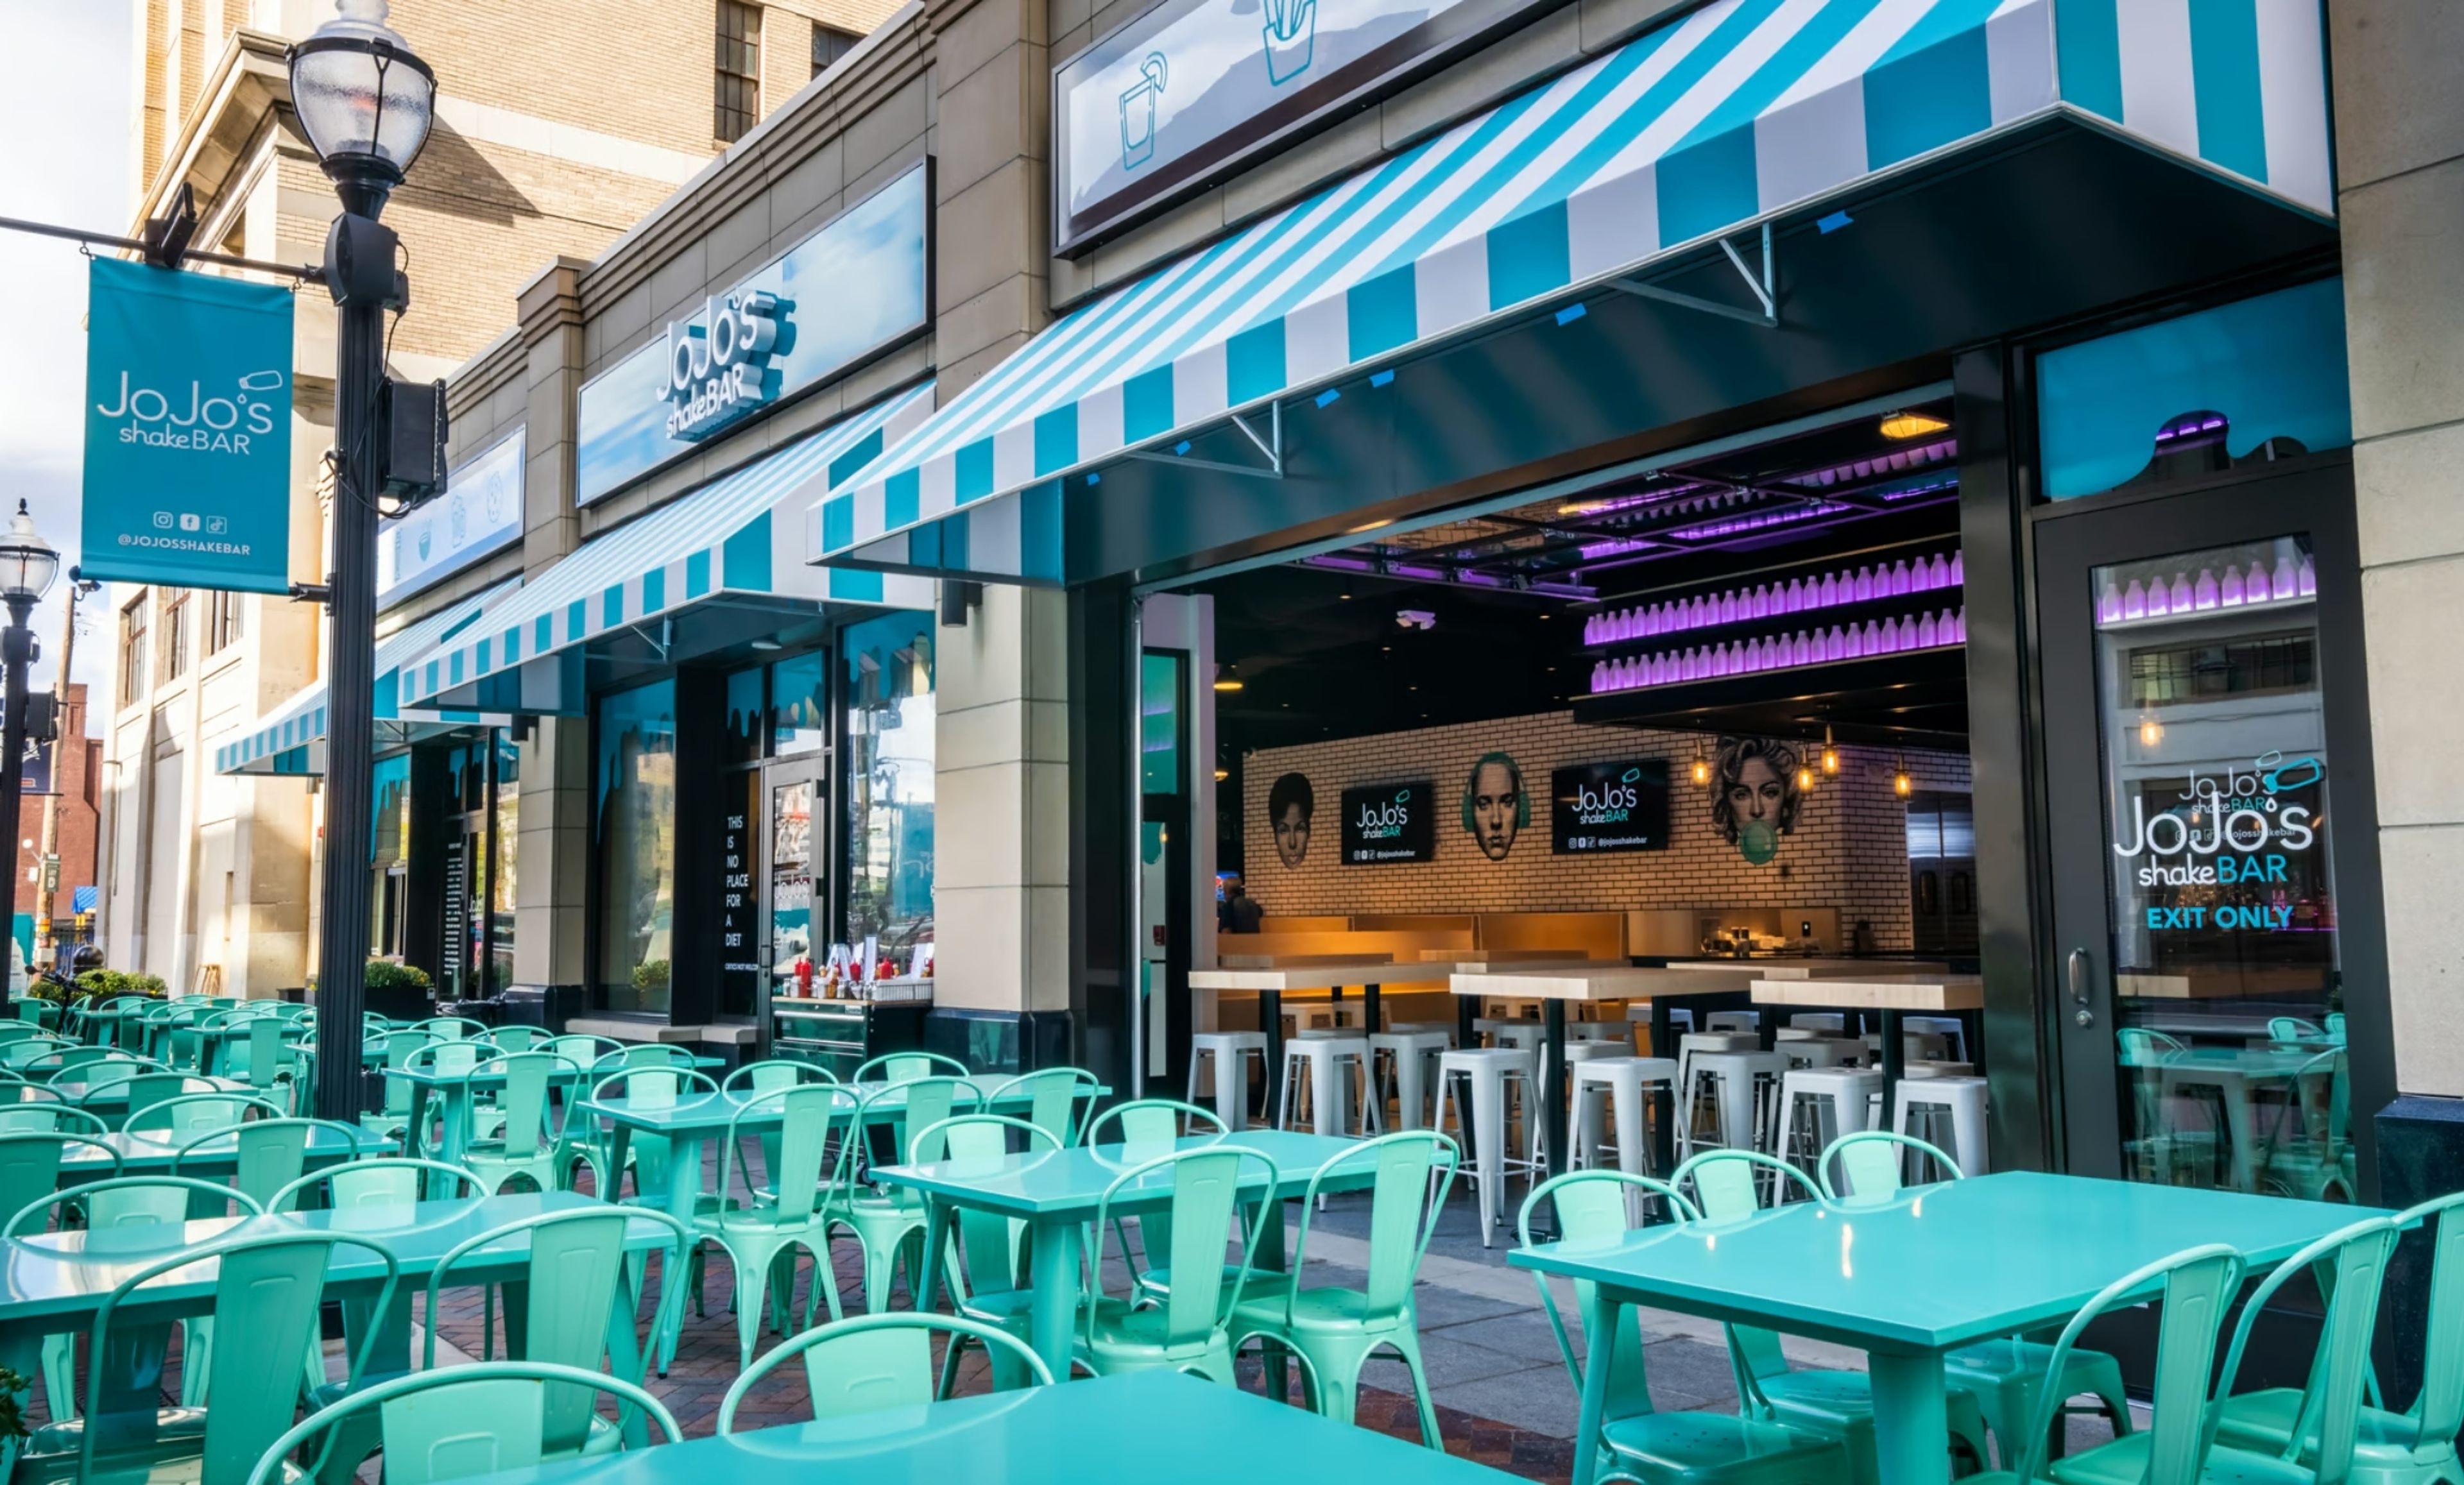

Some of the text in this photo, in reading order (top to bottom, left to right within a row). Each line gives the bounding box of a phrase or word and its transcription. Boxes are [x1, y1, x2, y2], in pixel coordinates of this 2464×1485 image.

[97, 371, 273, 434] JoJo's
[119, 420, 250, 455] shakeBAR
[118, 534, 251, 556] @JOJOSSHAKEBAR
[728, 815, 743, 829] THIS
[1580, 809, 1629, 825] shakeBAR
[2113, 791, 2313, 857] JoJo's
[1362, 825, 1401, 839] shakeBAR
[2220, 827, 2295, 840] @ojosshkebar
[727, 836, 734, 849] IS
[727, 855, 739, 869] NO
[2139, 853, 2288, 887] shakeBAR
[726, 874, 749, 888] PLACE
[726, 894, 740, 908] FOR
[726, 914, 732, 926] A
[2147, 905, 2294, 929] EXIT ONLY
[726, 933, 742, 947] DIET
